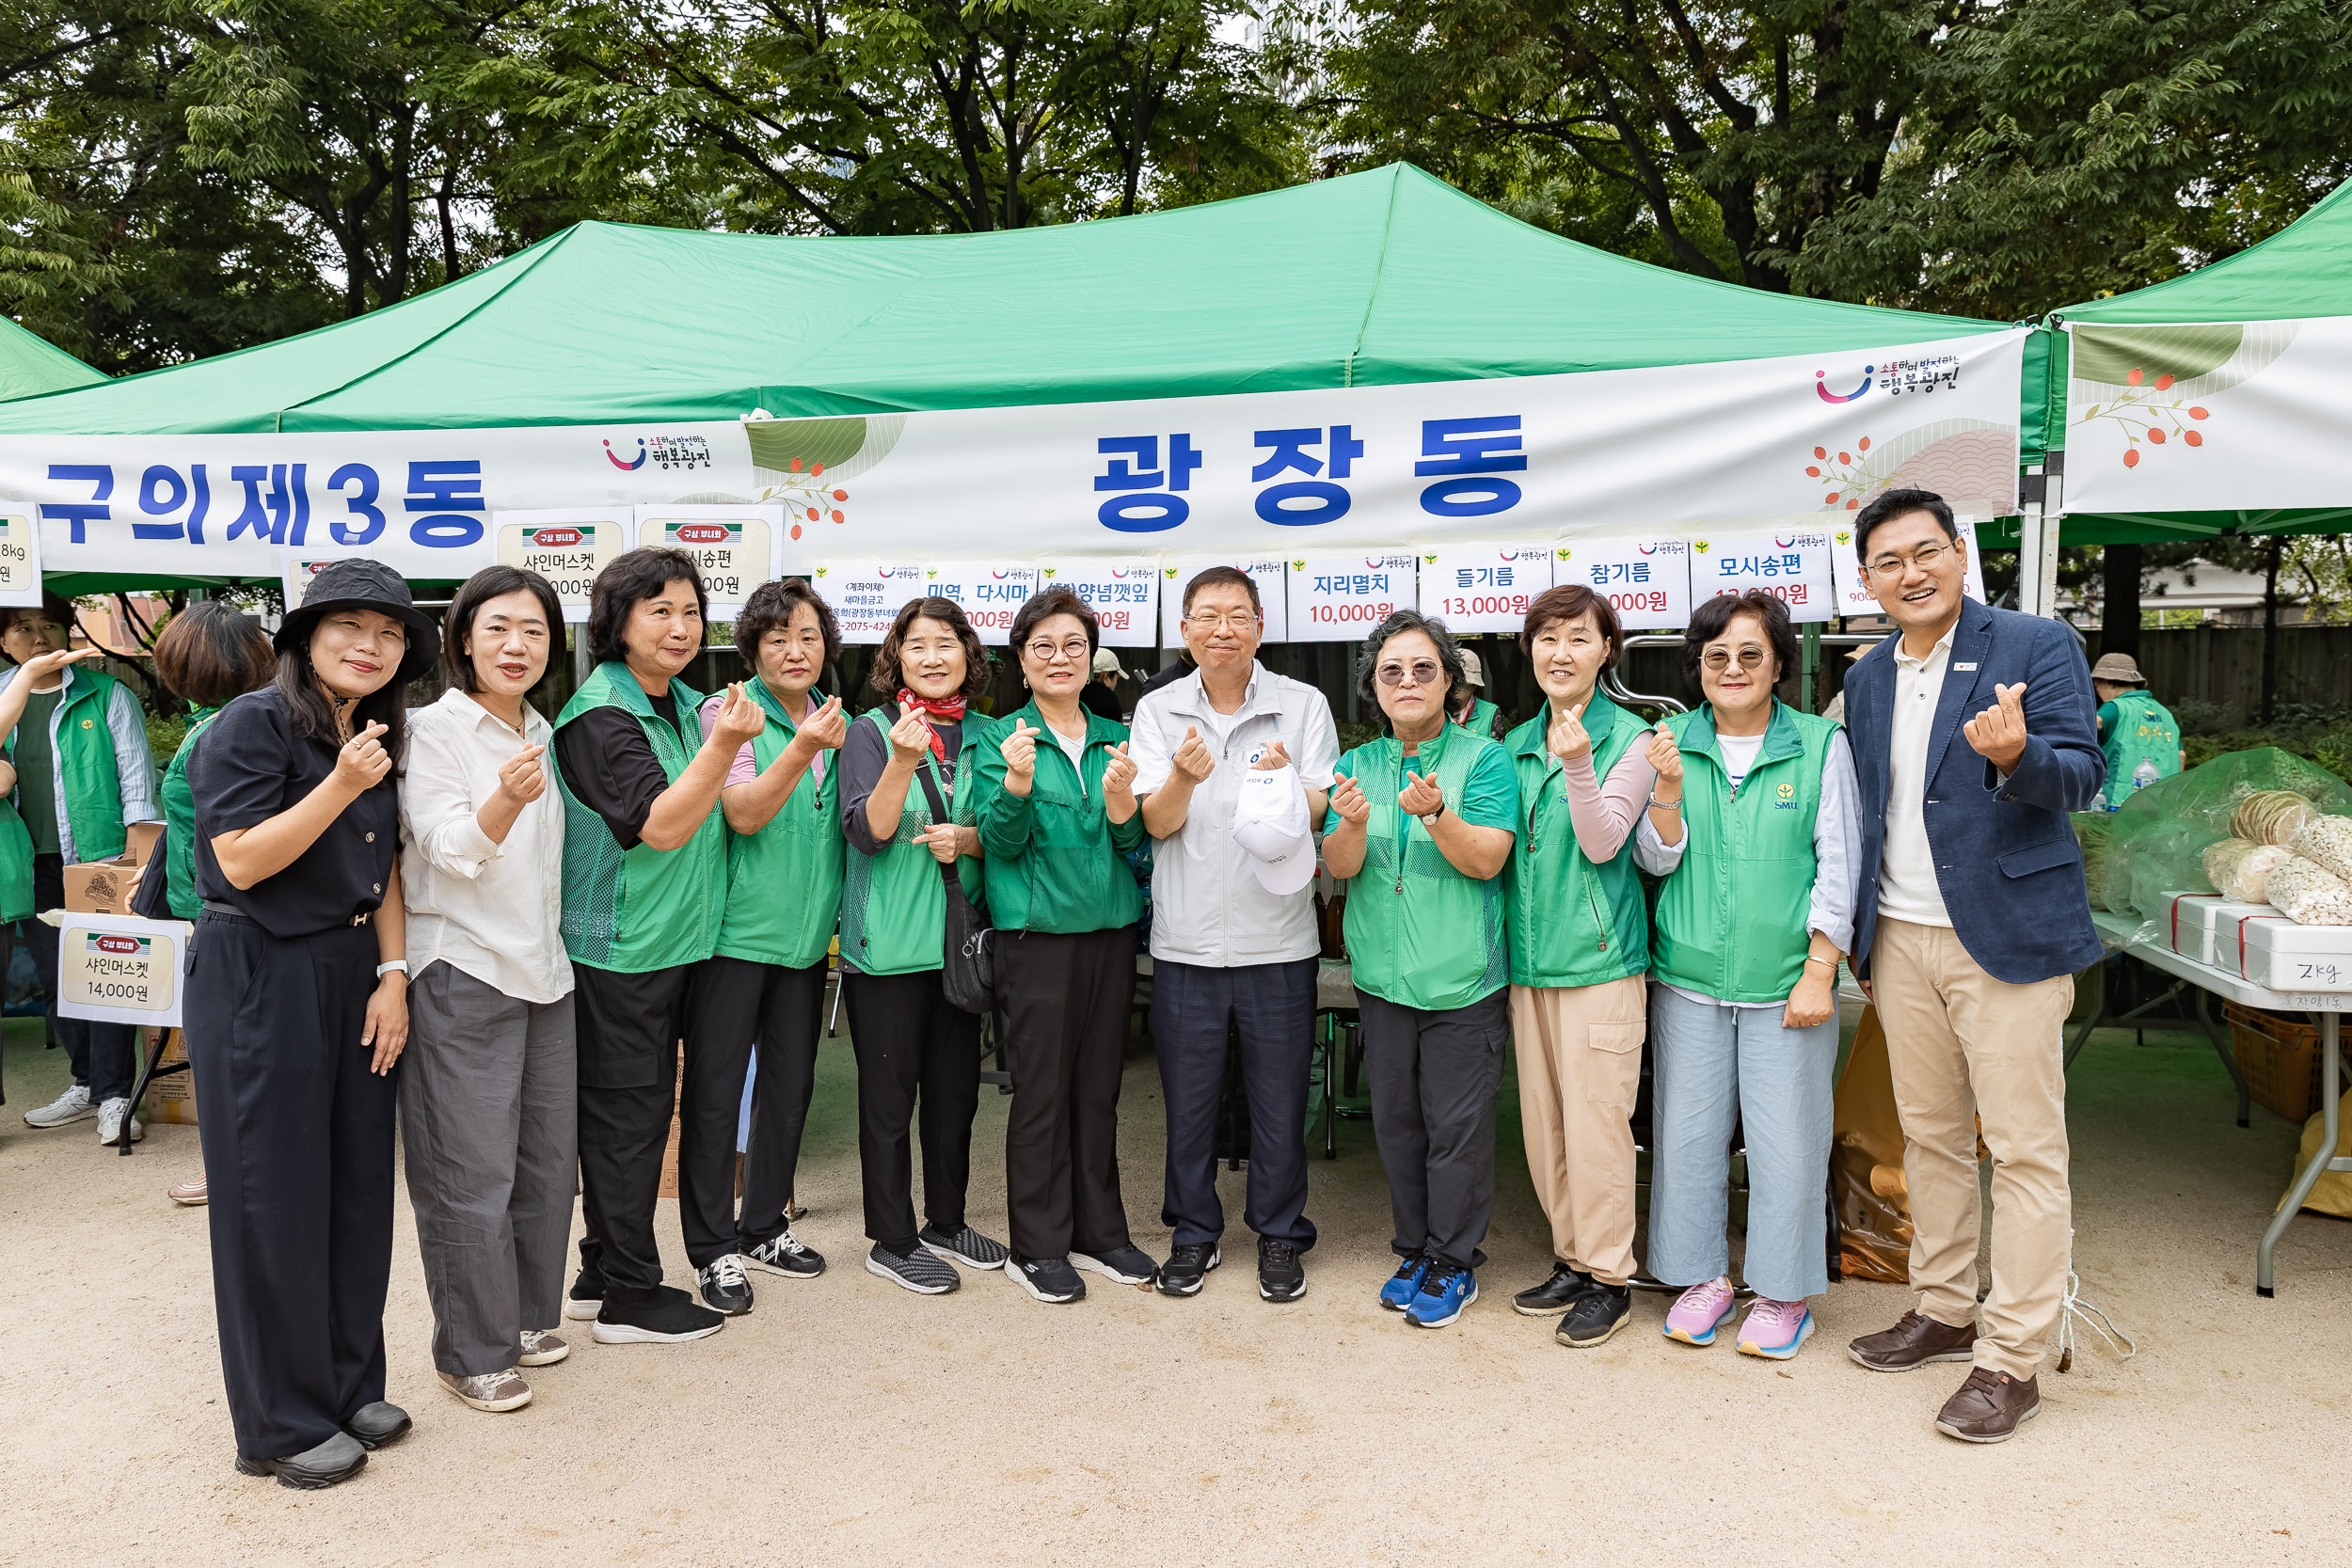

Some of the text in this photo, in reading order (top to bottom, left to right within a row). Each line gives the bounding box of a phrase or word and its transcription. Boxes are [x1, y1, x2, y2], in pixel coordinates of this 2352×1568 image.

[1880, 356, 1960, 377] 소통하며 발전하는
[1880, 366, 1960, 395] 행복광진
[649, 436, 707, 450] 소통하며 발전하는
[652, 447, 710, 469] 행복광진
[40, 460, 485, 547] 구의제3동
[1, 544, 24, 561] 8kg
[523, 552, 595, 571] 샤인머스켓
[691, 549, 731, 568] 시송편
[1590, 562, 1651, 584] 참기름
[1718, 553, 1802, 578] 모시송편
[550, 578, 595, 596] 000원
[703, 577, 739, 595] 00원
[1313, 574, 1389, 595] 지리멸치
[1455, 566, 1515, 588] 들기름
[844, 595, 883, 605] 새마을금고
[928, 584, 1029, 603] 미역, 다시마
[1608, 591, 1667, 611] 000원
[1310, 603, 1394, 625] 10,000원
[1442, 594, 1529, 617] 13,000원
[964, 610, 1014, 629] 000원
[1774, 801, 1798, 810] SMU
[86, 958, 148, 979] 샤인머스켓
[87, 981, 148, 1003] 14,000원
